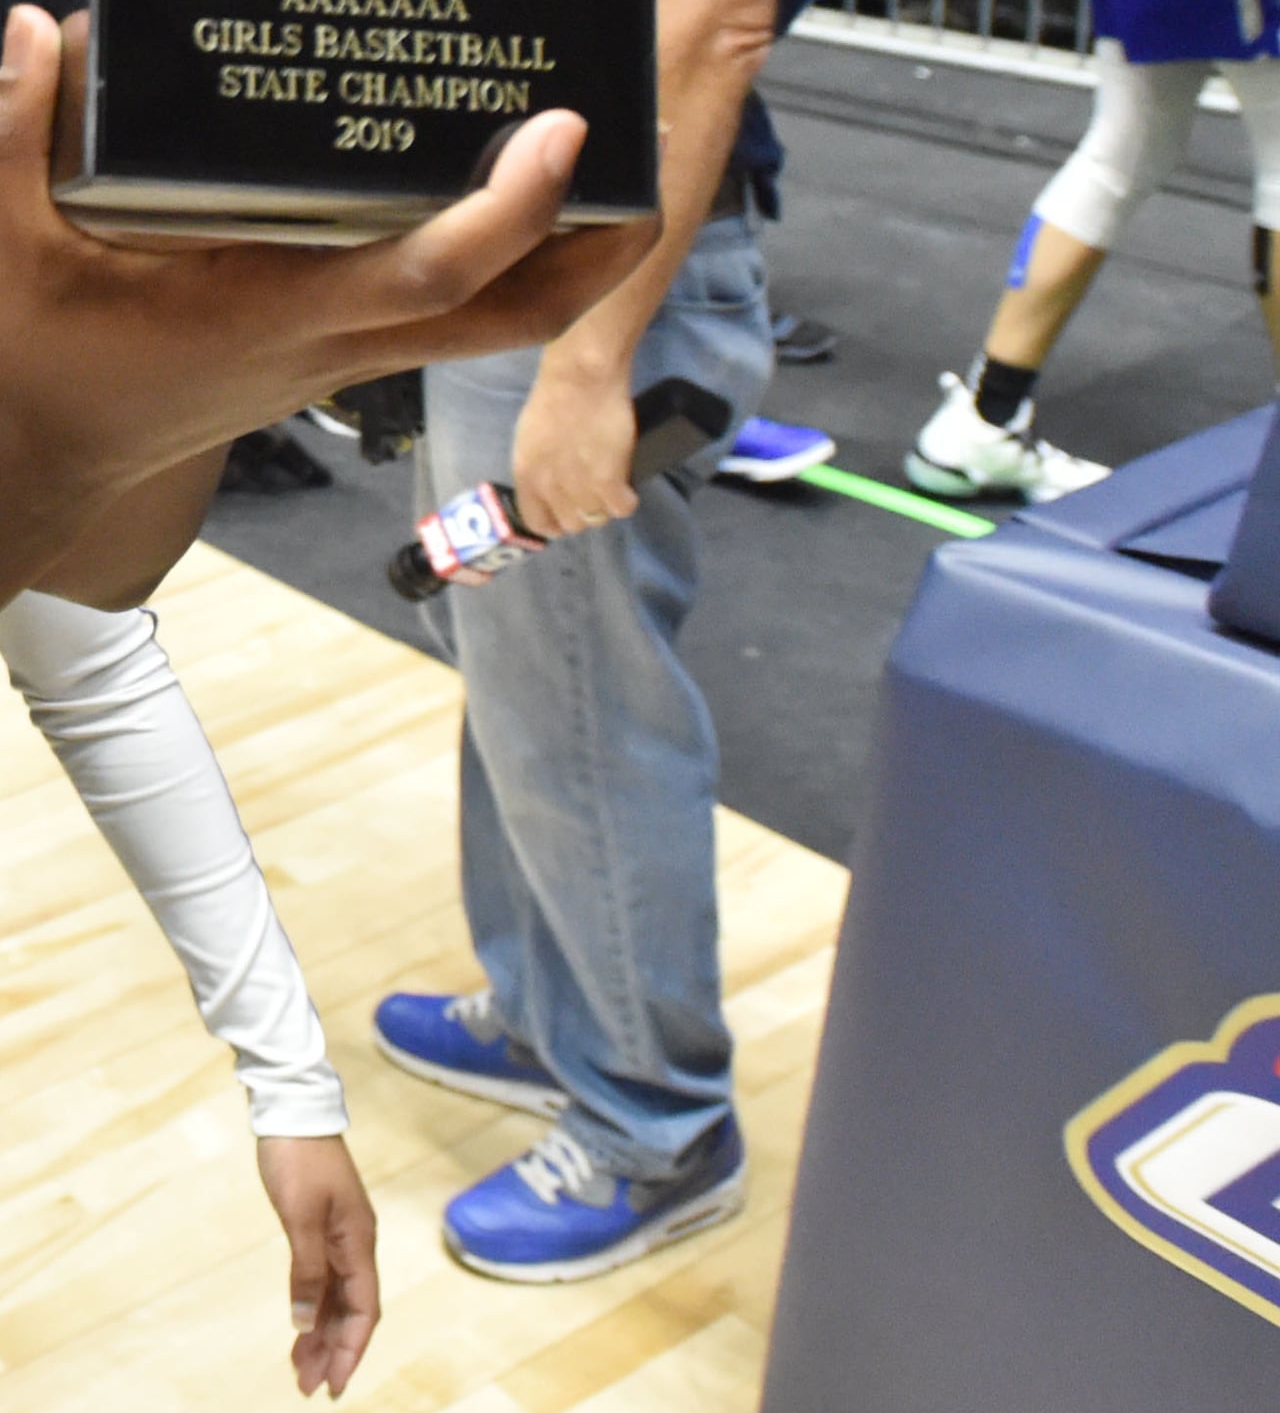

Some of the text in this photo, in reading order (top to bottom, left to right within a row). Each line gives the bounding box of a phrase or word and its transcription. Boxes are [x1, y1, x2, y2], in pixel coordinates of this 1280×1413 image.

[193, 18, 556, 71] GIRLS BASKETBALL
[219, 65, 531, 114] STATE CHAMPION
[334, 116, 416, 152] 2019
